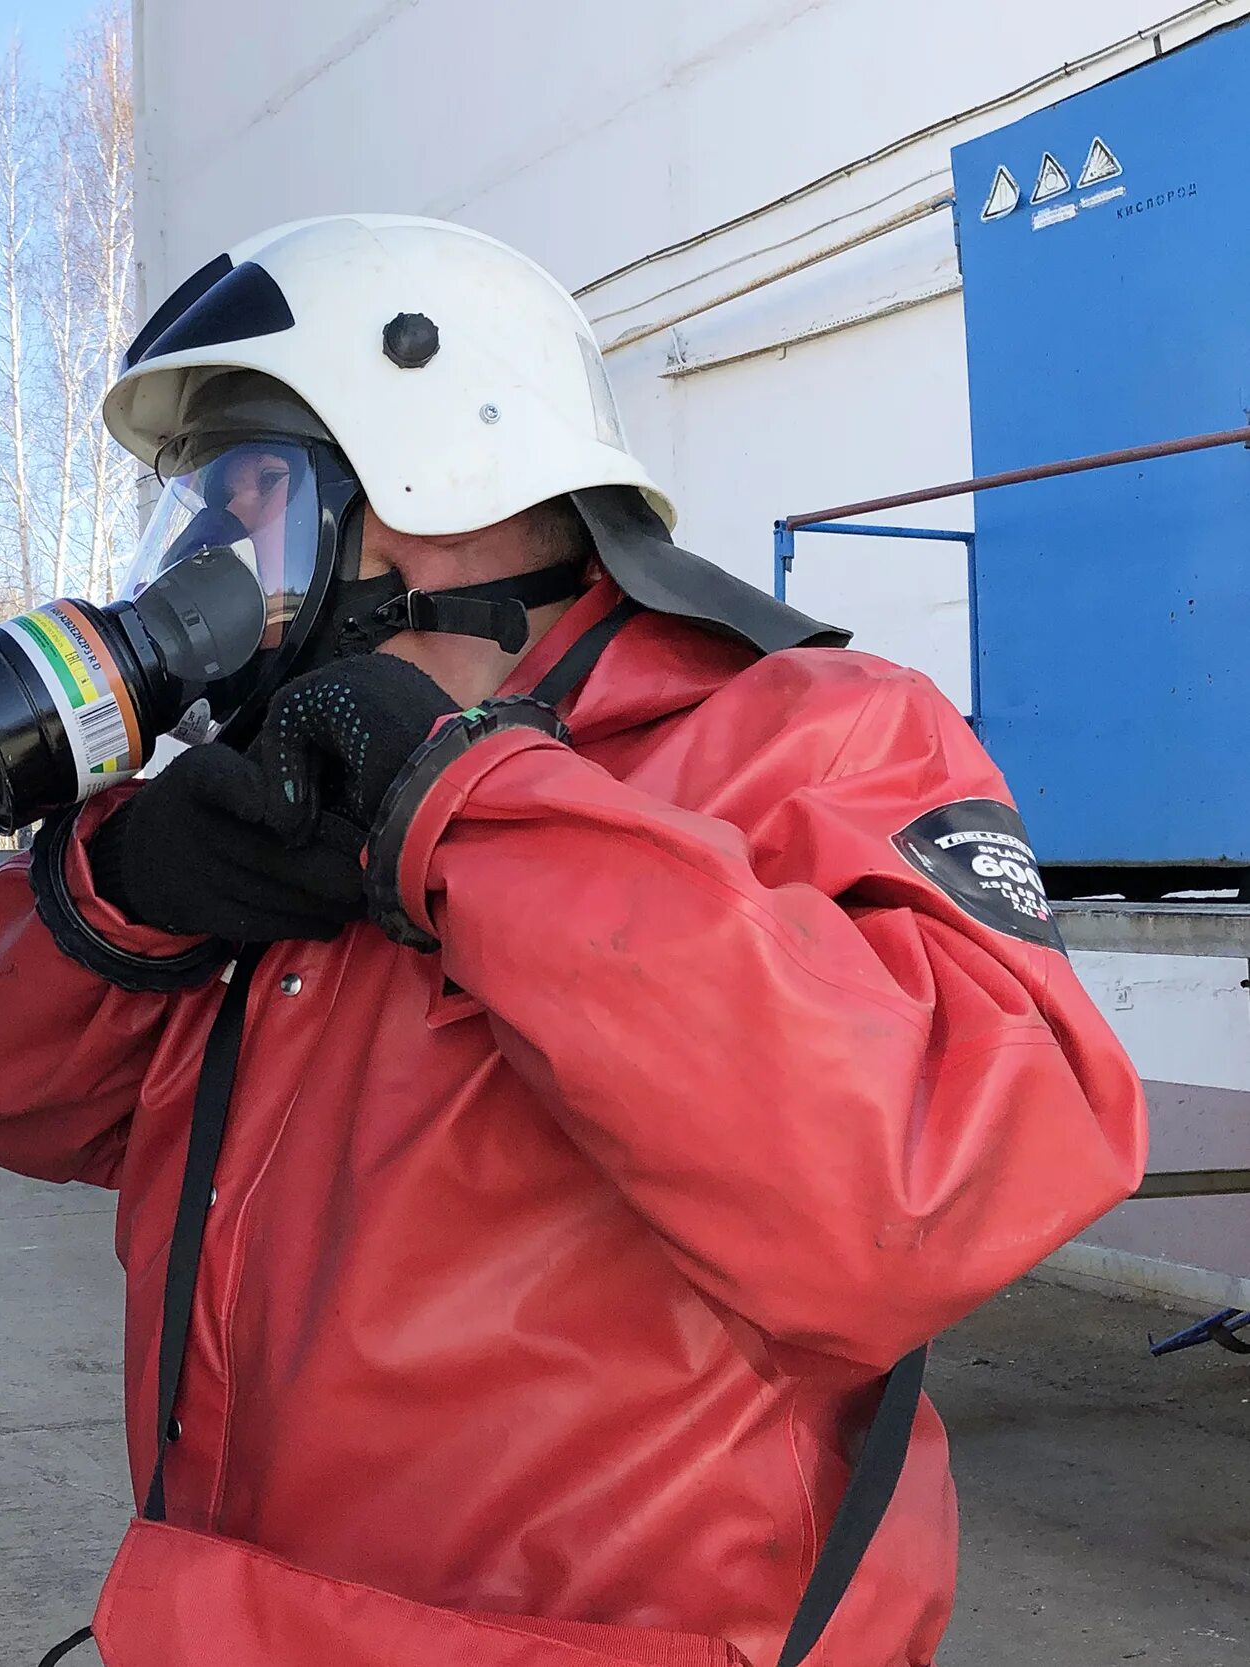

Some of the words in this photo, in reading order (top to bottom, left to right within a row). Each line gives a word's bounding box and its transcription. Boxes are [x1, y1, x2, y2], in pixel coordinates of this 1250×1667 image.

[88, 653, 97, 664] R
[92, 662, 102, 671] D
[977, 845, 1030, 865] SPLASH
[971, 854, 1047, 897] 600
[1011, 900, 1038, 918] XXL
